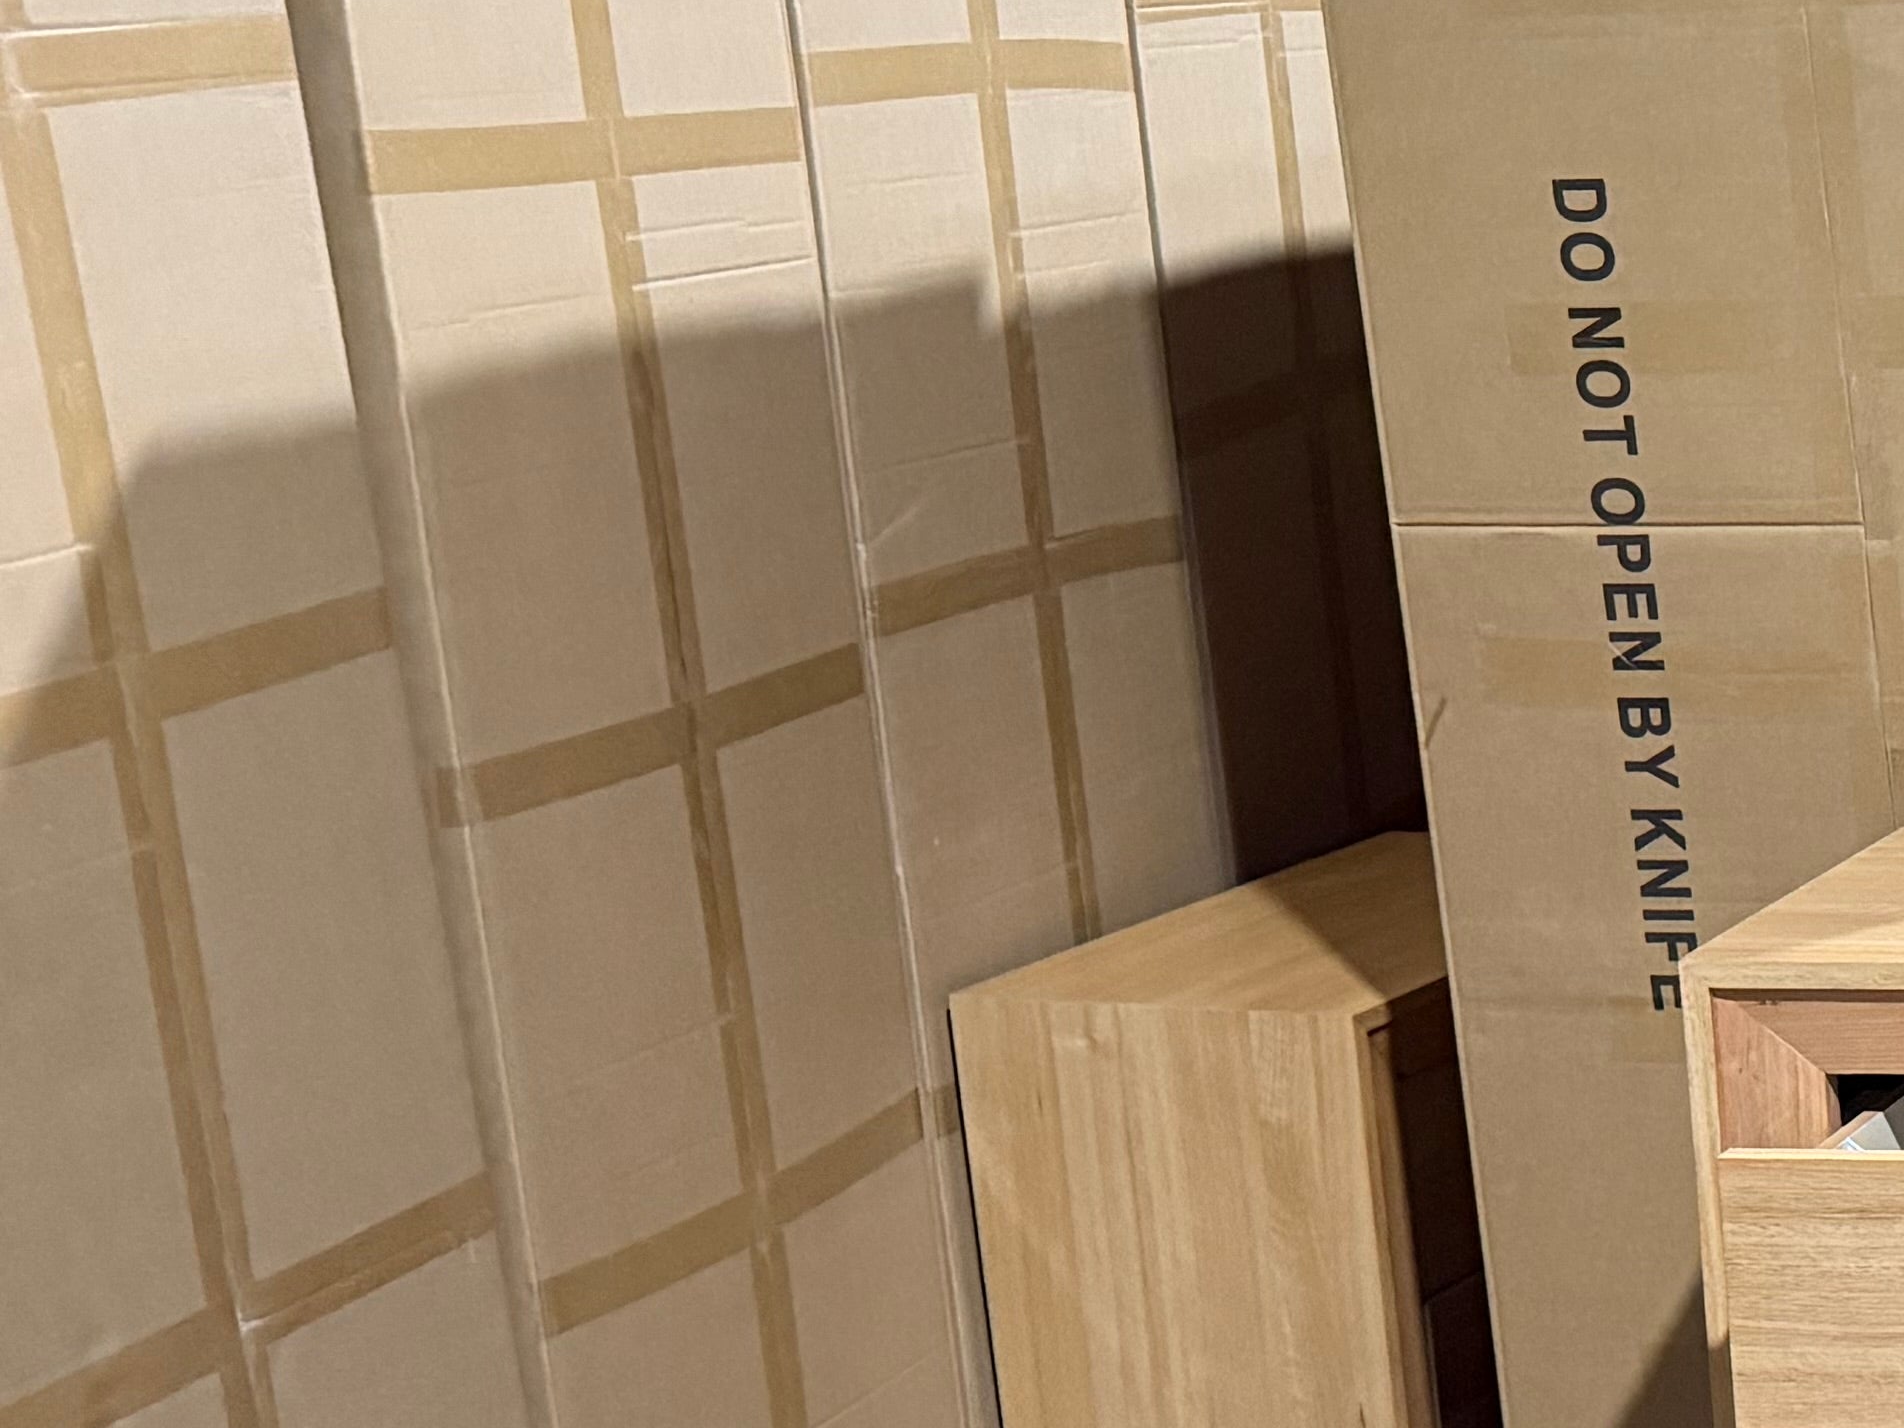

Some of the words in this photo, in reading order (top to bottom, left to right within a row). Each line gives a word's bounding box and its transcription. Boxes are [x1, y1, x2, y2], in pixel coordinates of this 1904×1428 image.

[1552, 178, 1615, 282] DO
[1568, 306, 1639, 456] NOT
[1591, 477, 1665, 672] OPEN
[1617, 697, 1680, 789] BY
[1631, 809, 1698, 1011] KNIFE
